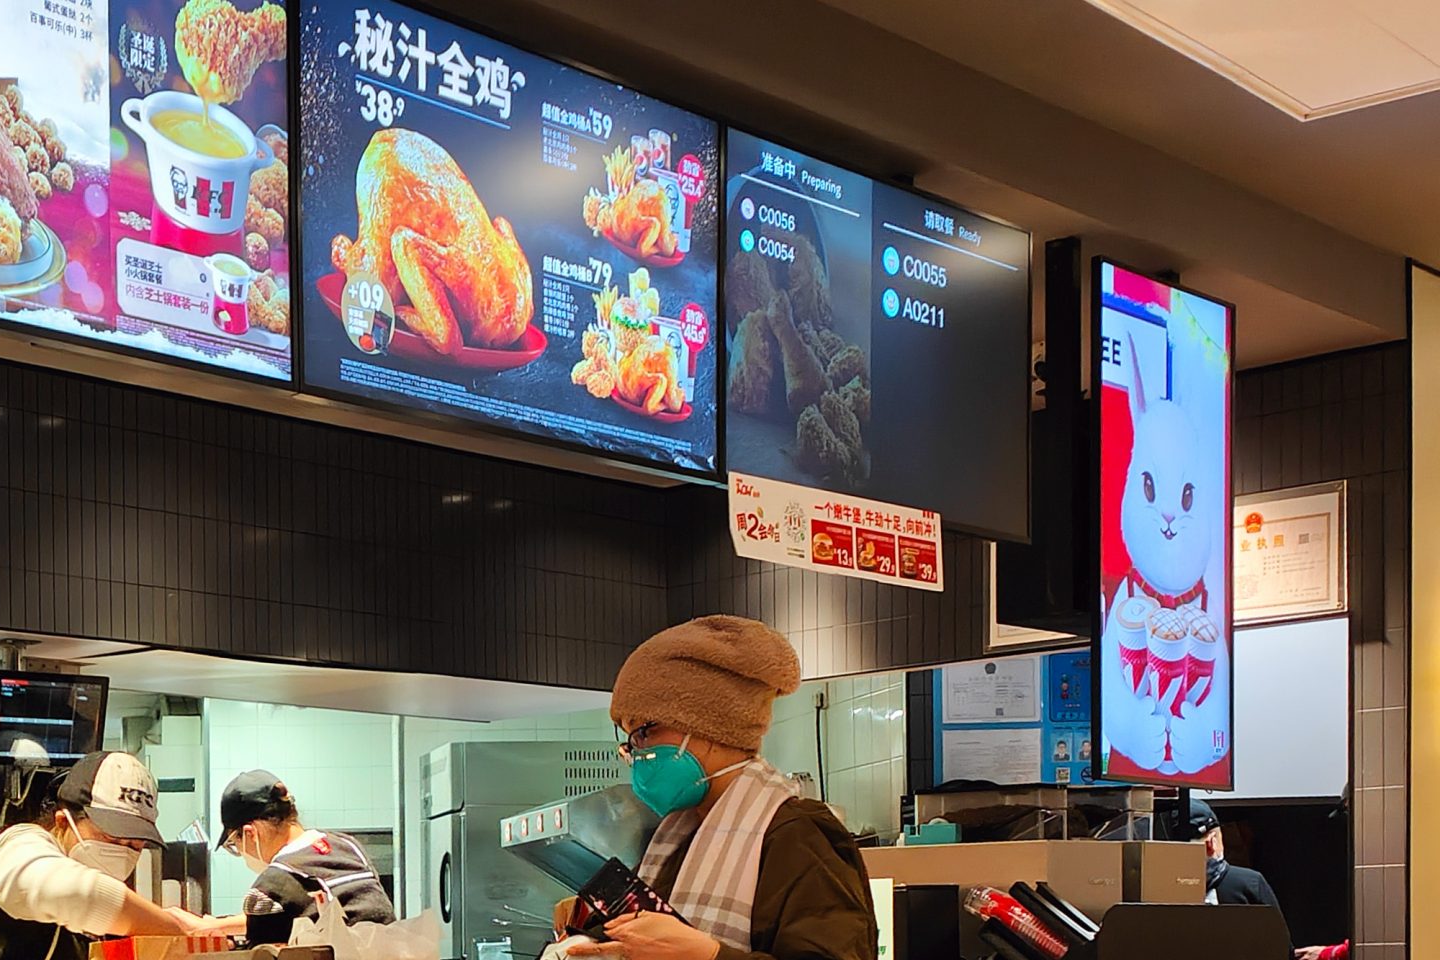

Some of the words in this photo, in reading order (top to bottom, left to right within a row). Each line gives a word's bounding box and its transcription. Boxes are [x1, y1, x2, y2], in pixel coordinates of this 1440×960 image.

[29, 11, 77, 39] 百事可乐(中)
[79, 29, 93, 42] 3杯
[44, 0, 76, 21] 葡式蛋挞
[79, 12, 93, 26] 2个
[130, 31, 156, 52] 圣诞
[130, 48, 156, 71] 限定
[354, 9, 512, 119] 秘汁全鸡
[761, 151, 796, 181] 准备中
[801, 169, 842, 199] Preparing
[759, 204, 796, 232] C0056
[924, 209, 954, 236] 请取餐
[958, 225, 982, 246] Ready
[758, 236, 796, 263] C0054
[903, 255, 947, 288] C0055
[902, 297, 945, 328] A0211
[118, 786, 153, 808] KFC
